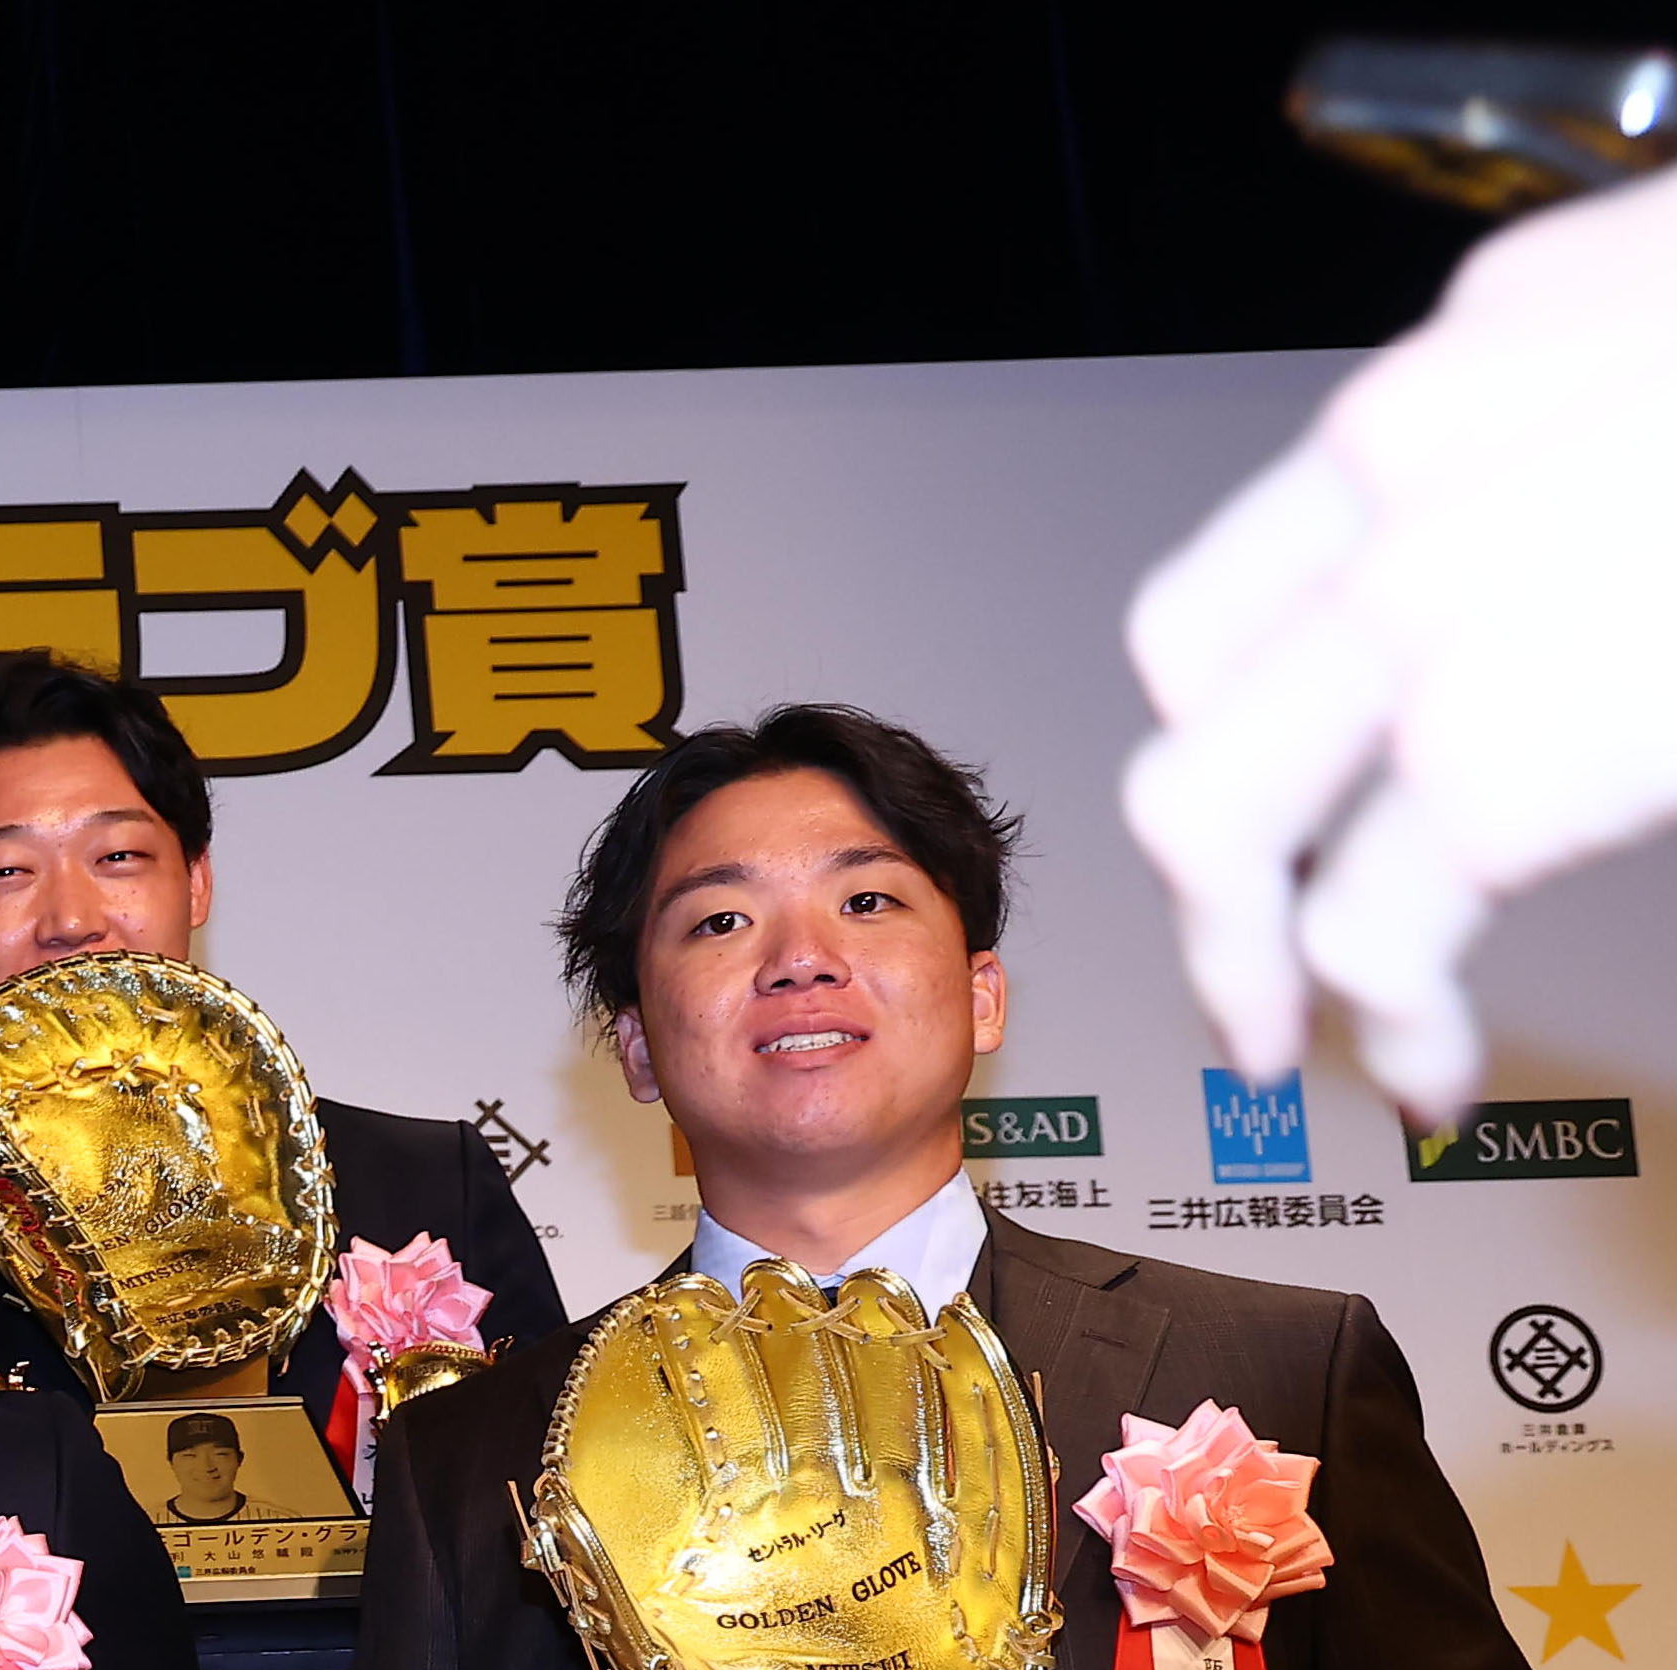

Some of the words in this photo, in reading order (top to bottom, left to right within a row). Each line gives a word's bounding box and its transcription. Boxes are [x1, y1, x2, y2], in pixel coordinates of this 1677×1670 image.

[960, 1110, 1089, 1145] S&AD
[1475, 1119, 1625, 1163] SMBC
[972, 1179, 1113, 1210] 住友海上
[1148, 1194, 1385, 1231] 三井広報委員会
[118, 1255, 197, 1291] MITSUI
[748, 1509, 847, 1563] セントラル・リーグ
[716, 1595, 836, 1630] GOLDEN
[851, 1551, 923, 1603] GLOVE
